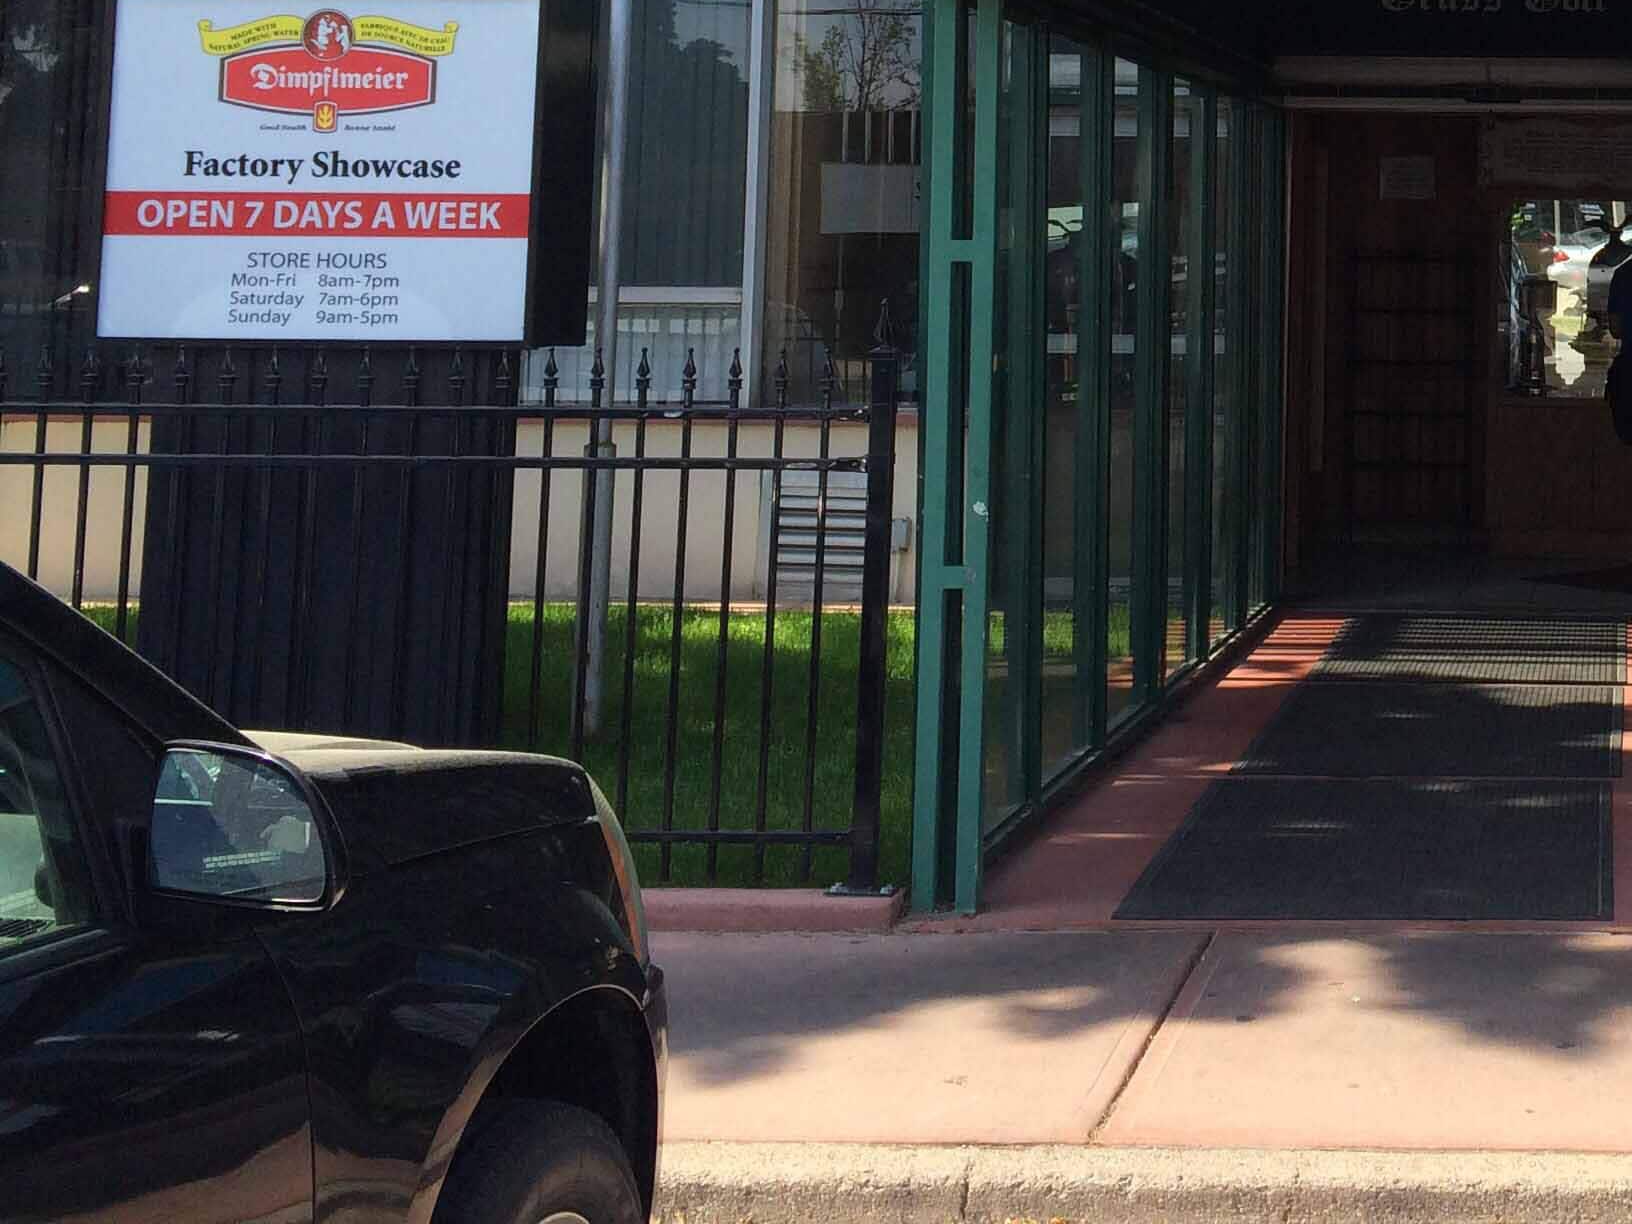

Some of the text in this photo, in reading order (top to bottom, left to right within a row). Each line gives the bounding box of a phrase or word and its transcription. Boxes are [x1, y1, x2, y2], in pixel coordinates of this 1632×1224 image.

[250, 63, 409, 97] Dimpflmeier
[183, 149, 461, 184] Factory Showcase
[136, 199, 502, 230] OPEN 7 DAYS A WEEK
[247, 252, 387, 270] STORE HOURS
[231, 273, 400, 291] Mon-Fri 8am-7pm
[230, 291, 399, 308] Saturday 7am-6pm
[228, 309, 398, 327] Sunday 9am-5pm
